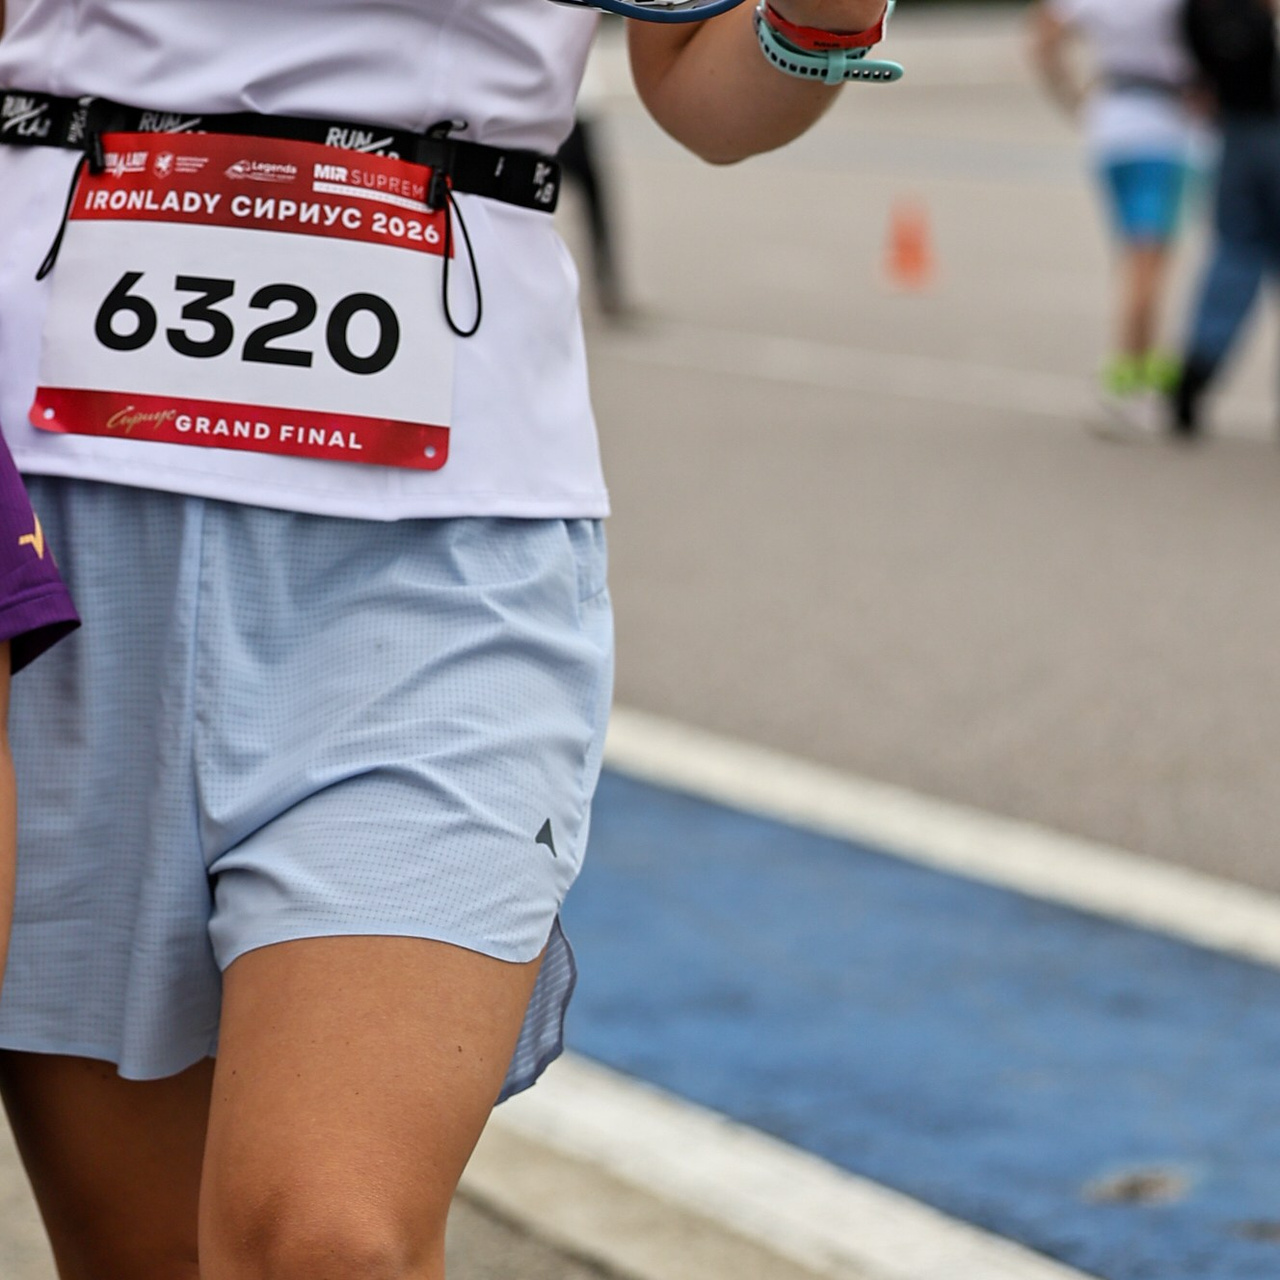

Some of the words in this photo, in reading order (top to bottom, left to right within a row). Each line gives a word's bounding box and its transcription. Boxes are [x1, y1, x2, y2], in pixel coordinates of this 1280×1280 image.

[138, 111, 181, 133] RUN
[325, 126, 373, 150] RUN
[313, 163, 348, 182] MIR
[351, 168, 425, 200] SUPREM
[84, 189, 222, 215] IRONLADY
[231, 195, 362, 230] СИРИУС
[371, 212, 441, 245] 2026
[94, 270, 400, 375] 6320
[175, 414, 270, 439] GRAND
[279, 424, 363, 450] FINAL
